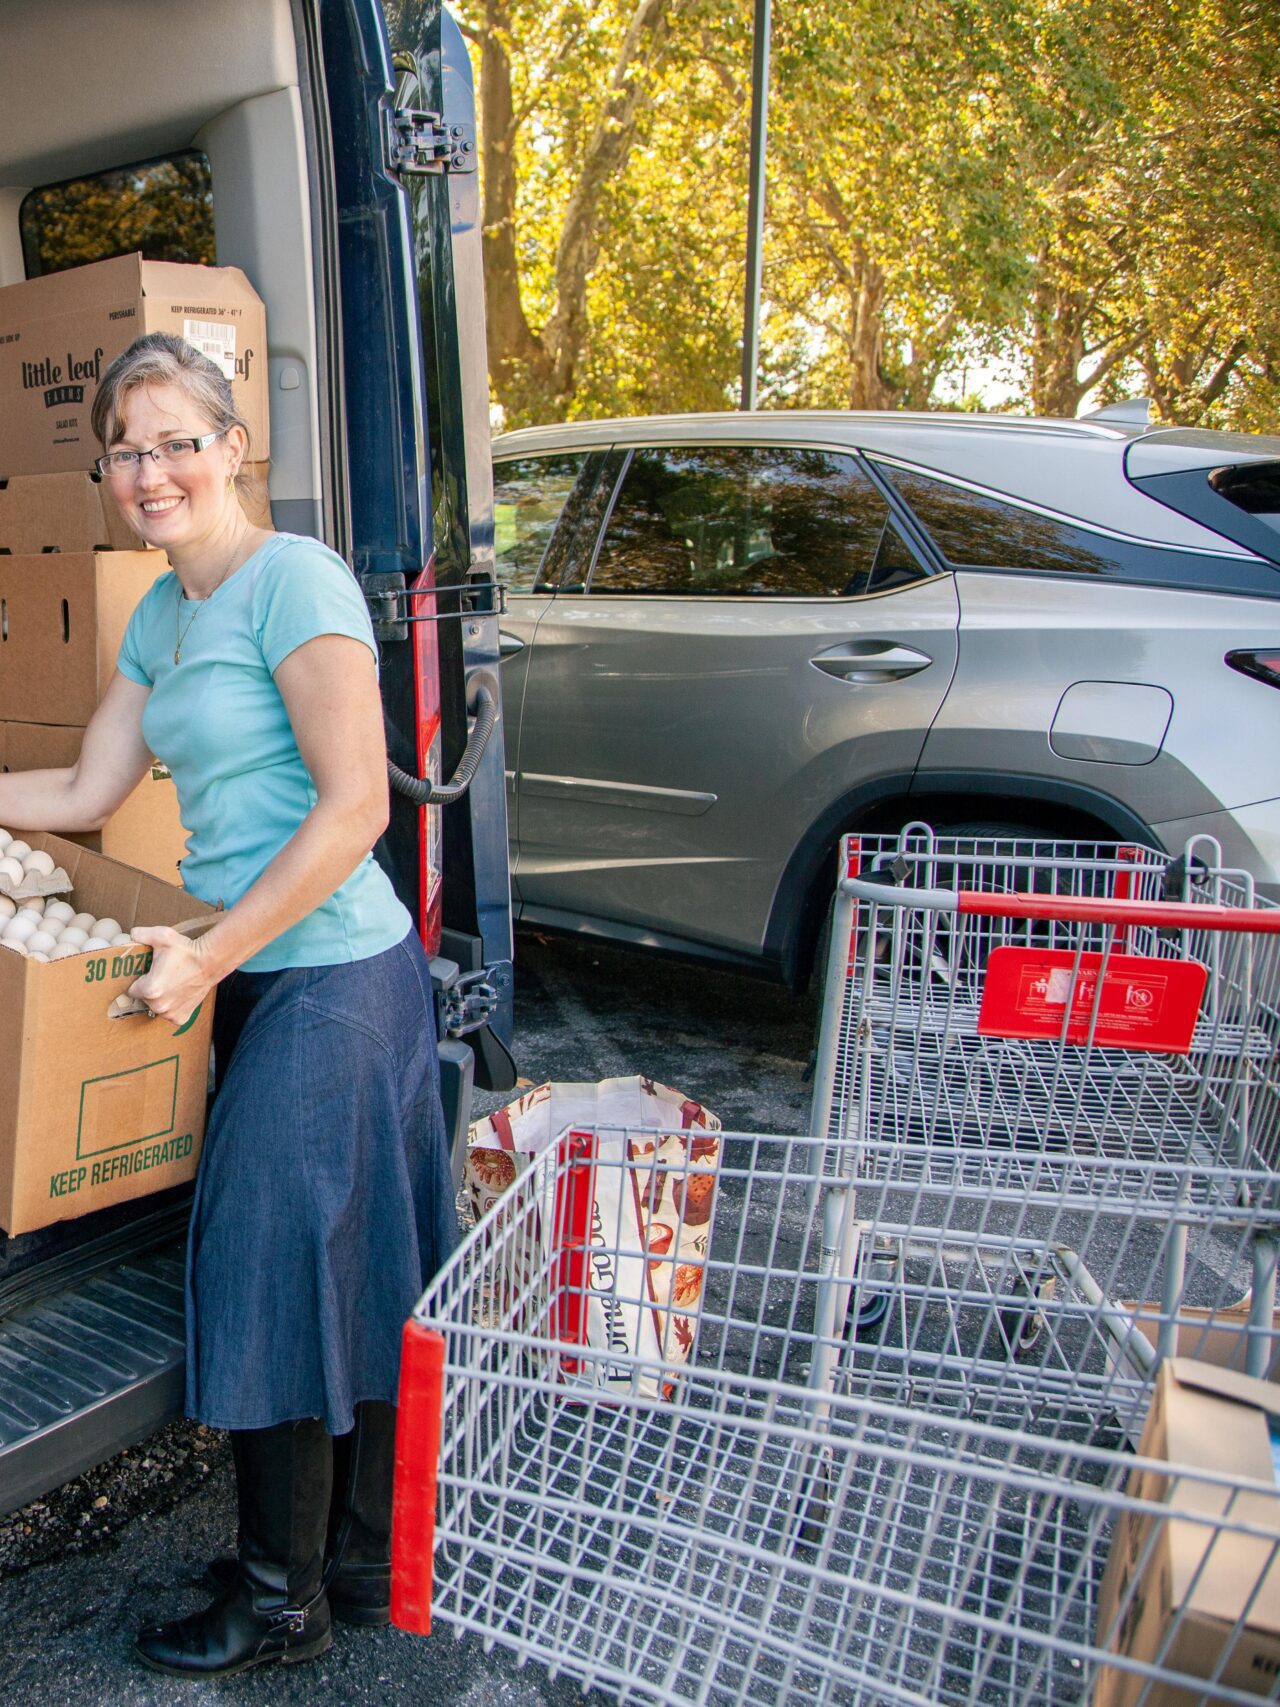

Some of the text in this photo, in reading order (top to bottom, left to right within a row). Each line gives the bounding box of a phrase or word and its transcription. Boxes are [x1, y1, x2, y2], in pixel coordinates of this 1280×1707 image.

[109, 308, 136, 321] PERISHABLE
[171, 305, 183, 313] KEEP
[183, 306, 217, 315] REFRIGERATED
[22, 347, 104, 389] little leaf
[235, 348, 254, 381] af
[46, 387, 81, 405] FARMS
[56, 418, 78, 430] SALAD KITS
[84, 951, 153, 983] 30 DOZE
[49, 1133, 193, 1199] KEEP REFRIGERATED
